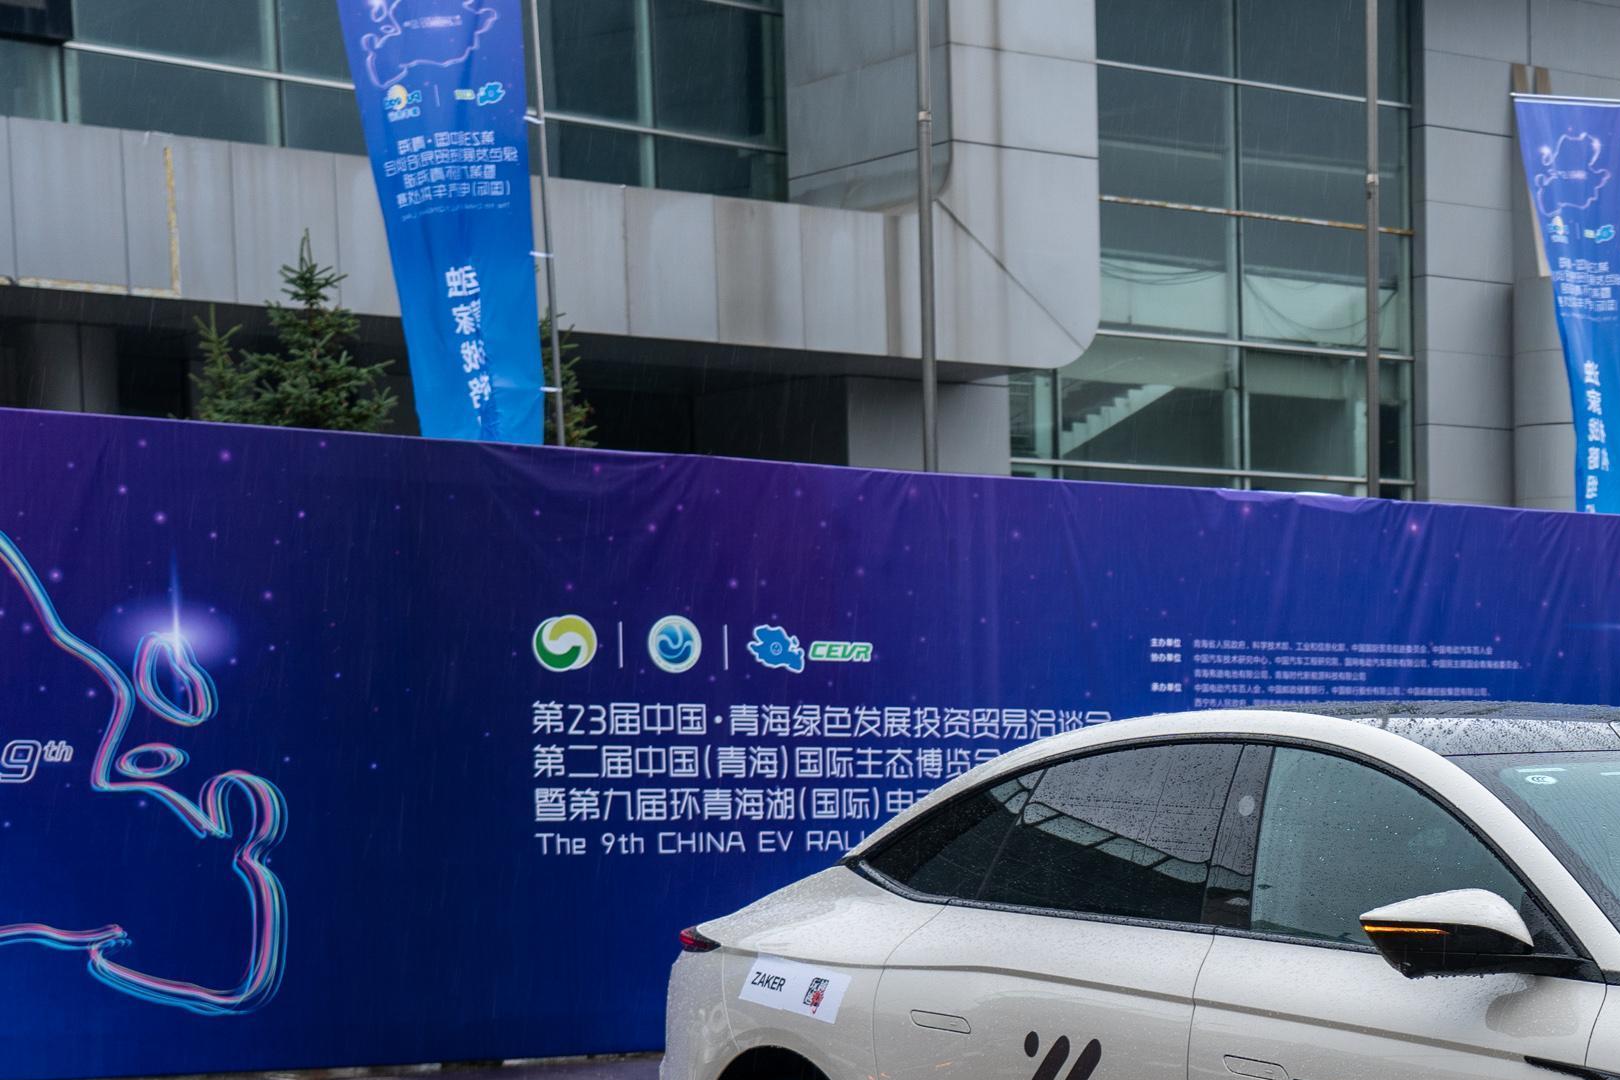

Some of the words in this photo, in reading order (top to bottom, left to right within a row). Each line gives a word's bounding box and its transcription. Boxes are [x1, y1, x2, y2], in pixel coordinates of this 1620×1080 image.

[809, 641, 873, 661] CEVR
[534, 787, 935, 822] 暨第九届环青海湖(国际)电
[534, 832, 586, 855] The
[601, 832, 645, 855] 9th
[658, 831, 746, 854] CHINA
[758, 830, 794, 852] EV
[751, 972, 786, 992] ZAKER
